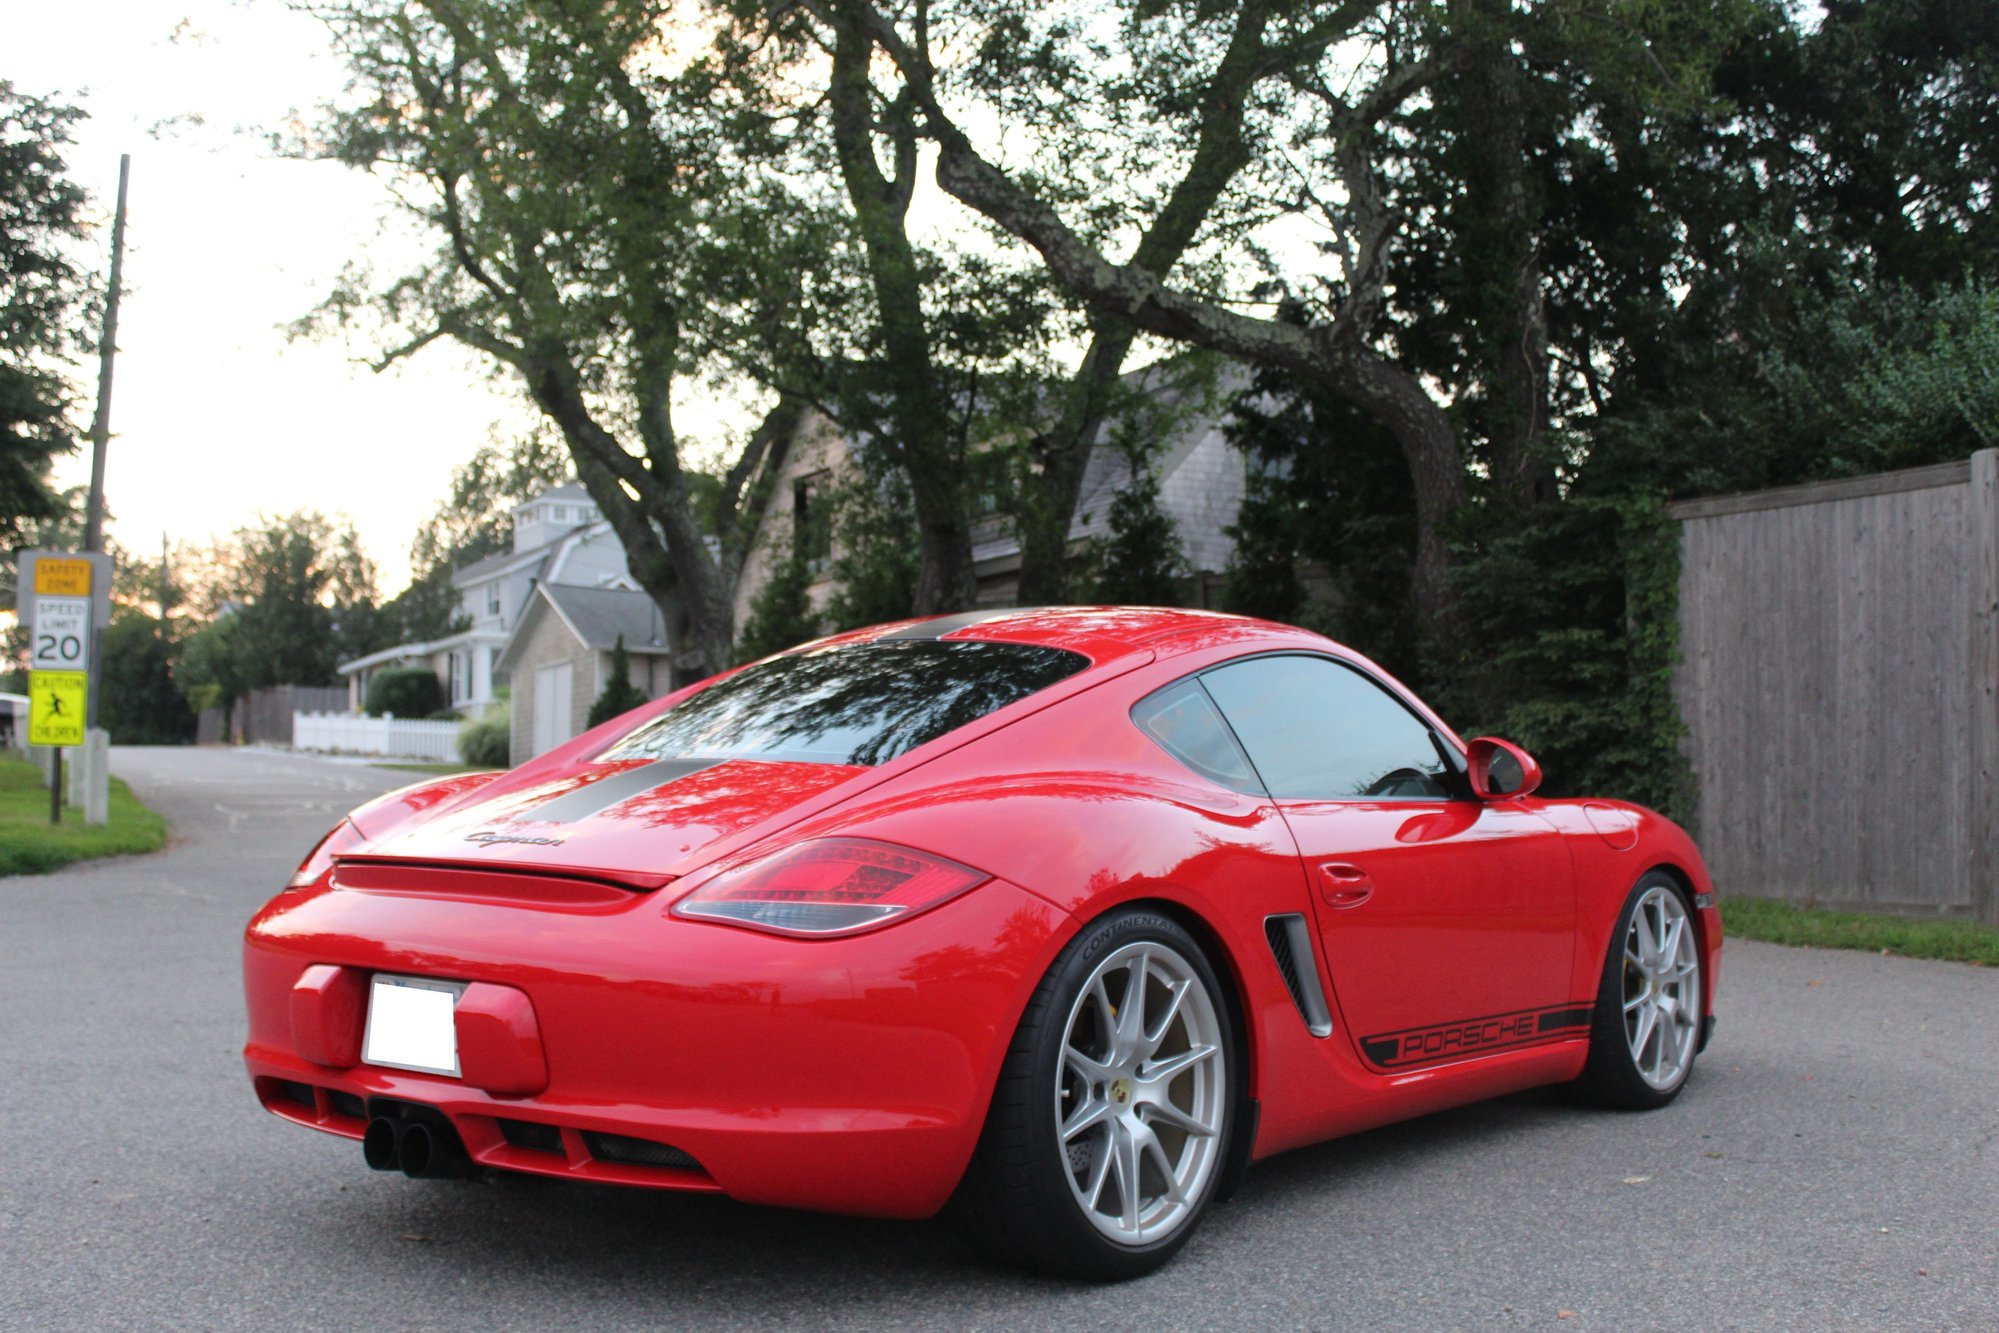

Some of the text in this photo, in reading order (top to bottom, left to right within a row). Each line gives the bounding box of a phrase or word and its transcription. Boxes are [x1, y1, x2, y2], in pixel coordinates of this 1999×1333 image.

[41, 564, 85, 576] SAFETY
[47, 577, 77, 590] ZONE
[39, 603, 84, 615] SPEED
[42, 618, 78, 630] LIMIT
[38, 635, 80, 660] 20
[33, 676, 83, 690] CAUTION
[35, 725, 78, 738] CHILDREN
[464, 831, 565, 848] Cayman
[1403, 1015, 1533, 1057] PORSCHE
